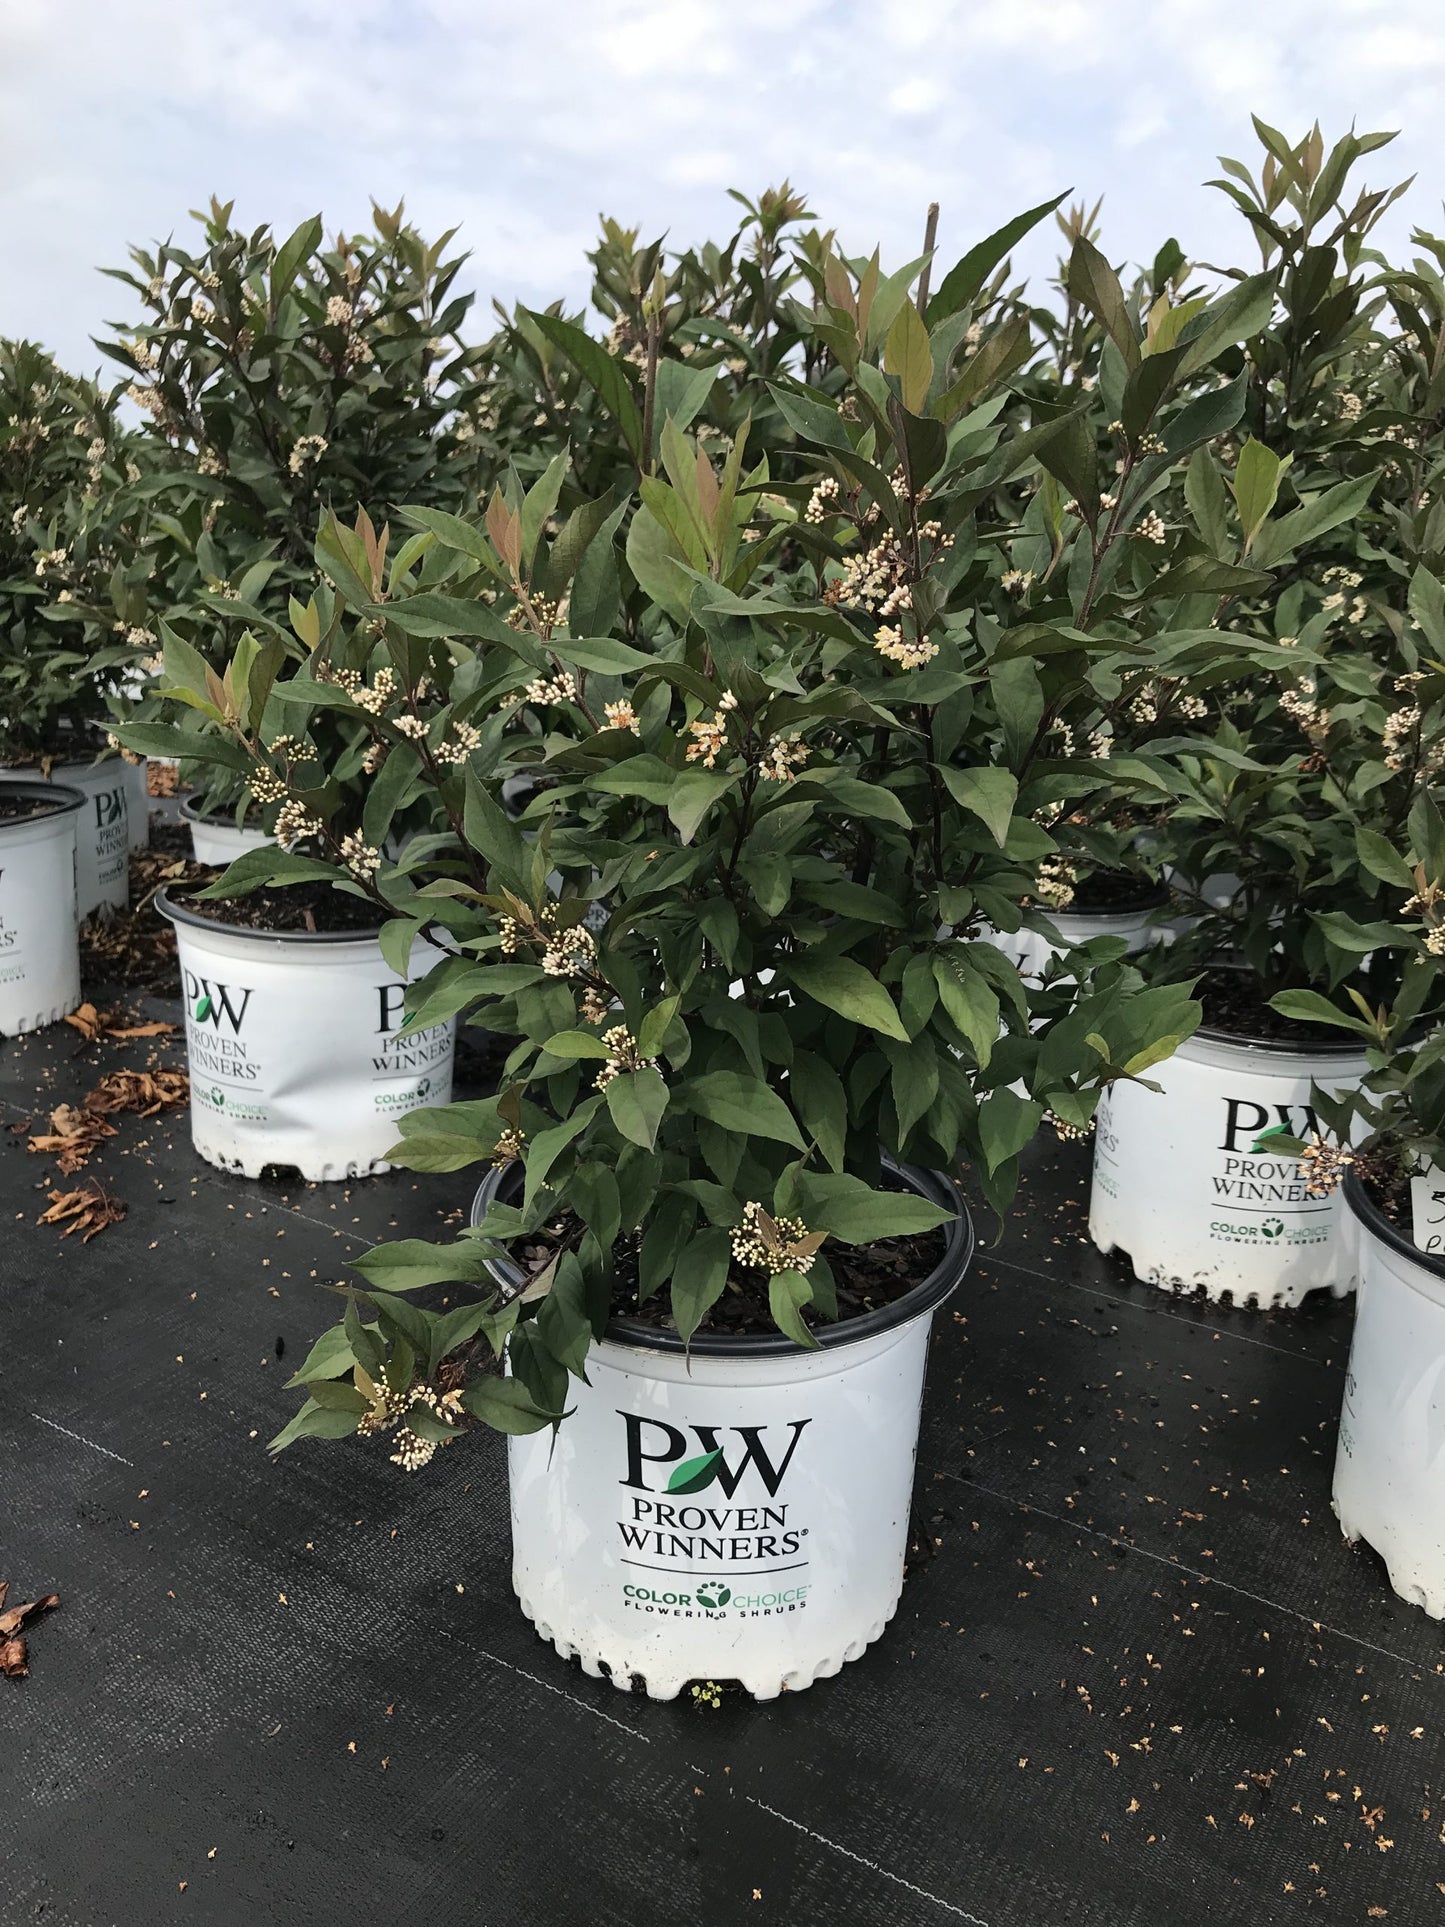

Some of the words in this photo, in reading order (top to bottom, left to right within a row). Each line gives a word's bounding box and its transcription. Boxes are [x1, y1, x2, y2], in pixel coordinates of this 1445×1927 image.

[184, 967, 255, 1036] PW
[189, 1023, 248, 1059] PROVEN
[374, 1091, 415, 1104] COLOR
[1224, 1158, 1312, 1181] PROVE
[1210, 1222, 1258, 1236] COLOR
[1284, 1225, 1329, 1238] CHOICE
[615, 1409, 812, 1500] PW
[631, 1497, 789, 1531] PROVEN
[623, 1585, 691, 1606] COLOR
[732, 1587, 808, 1609] CHOICE
[624, 1600, 727, 1618] FLOWERING
[740, 1601, 806, 1618] SHRUBS
